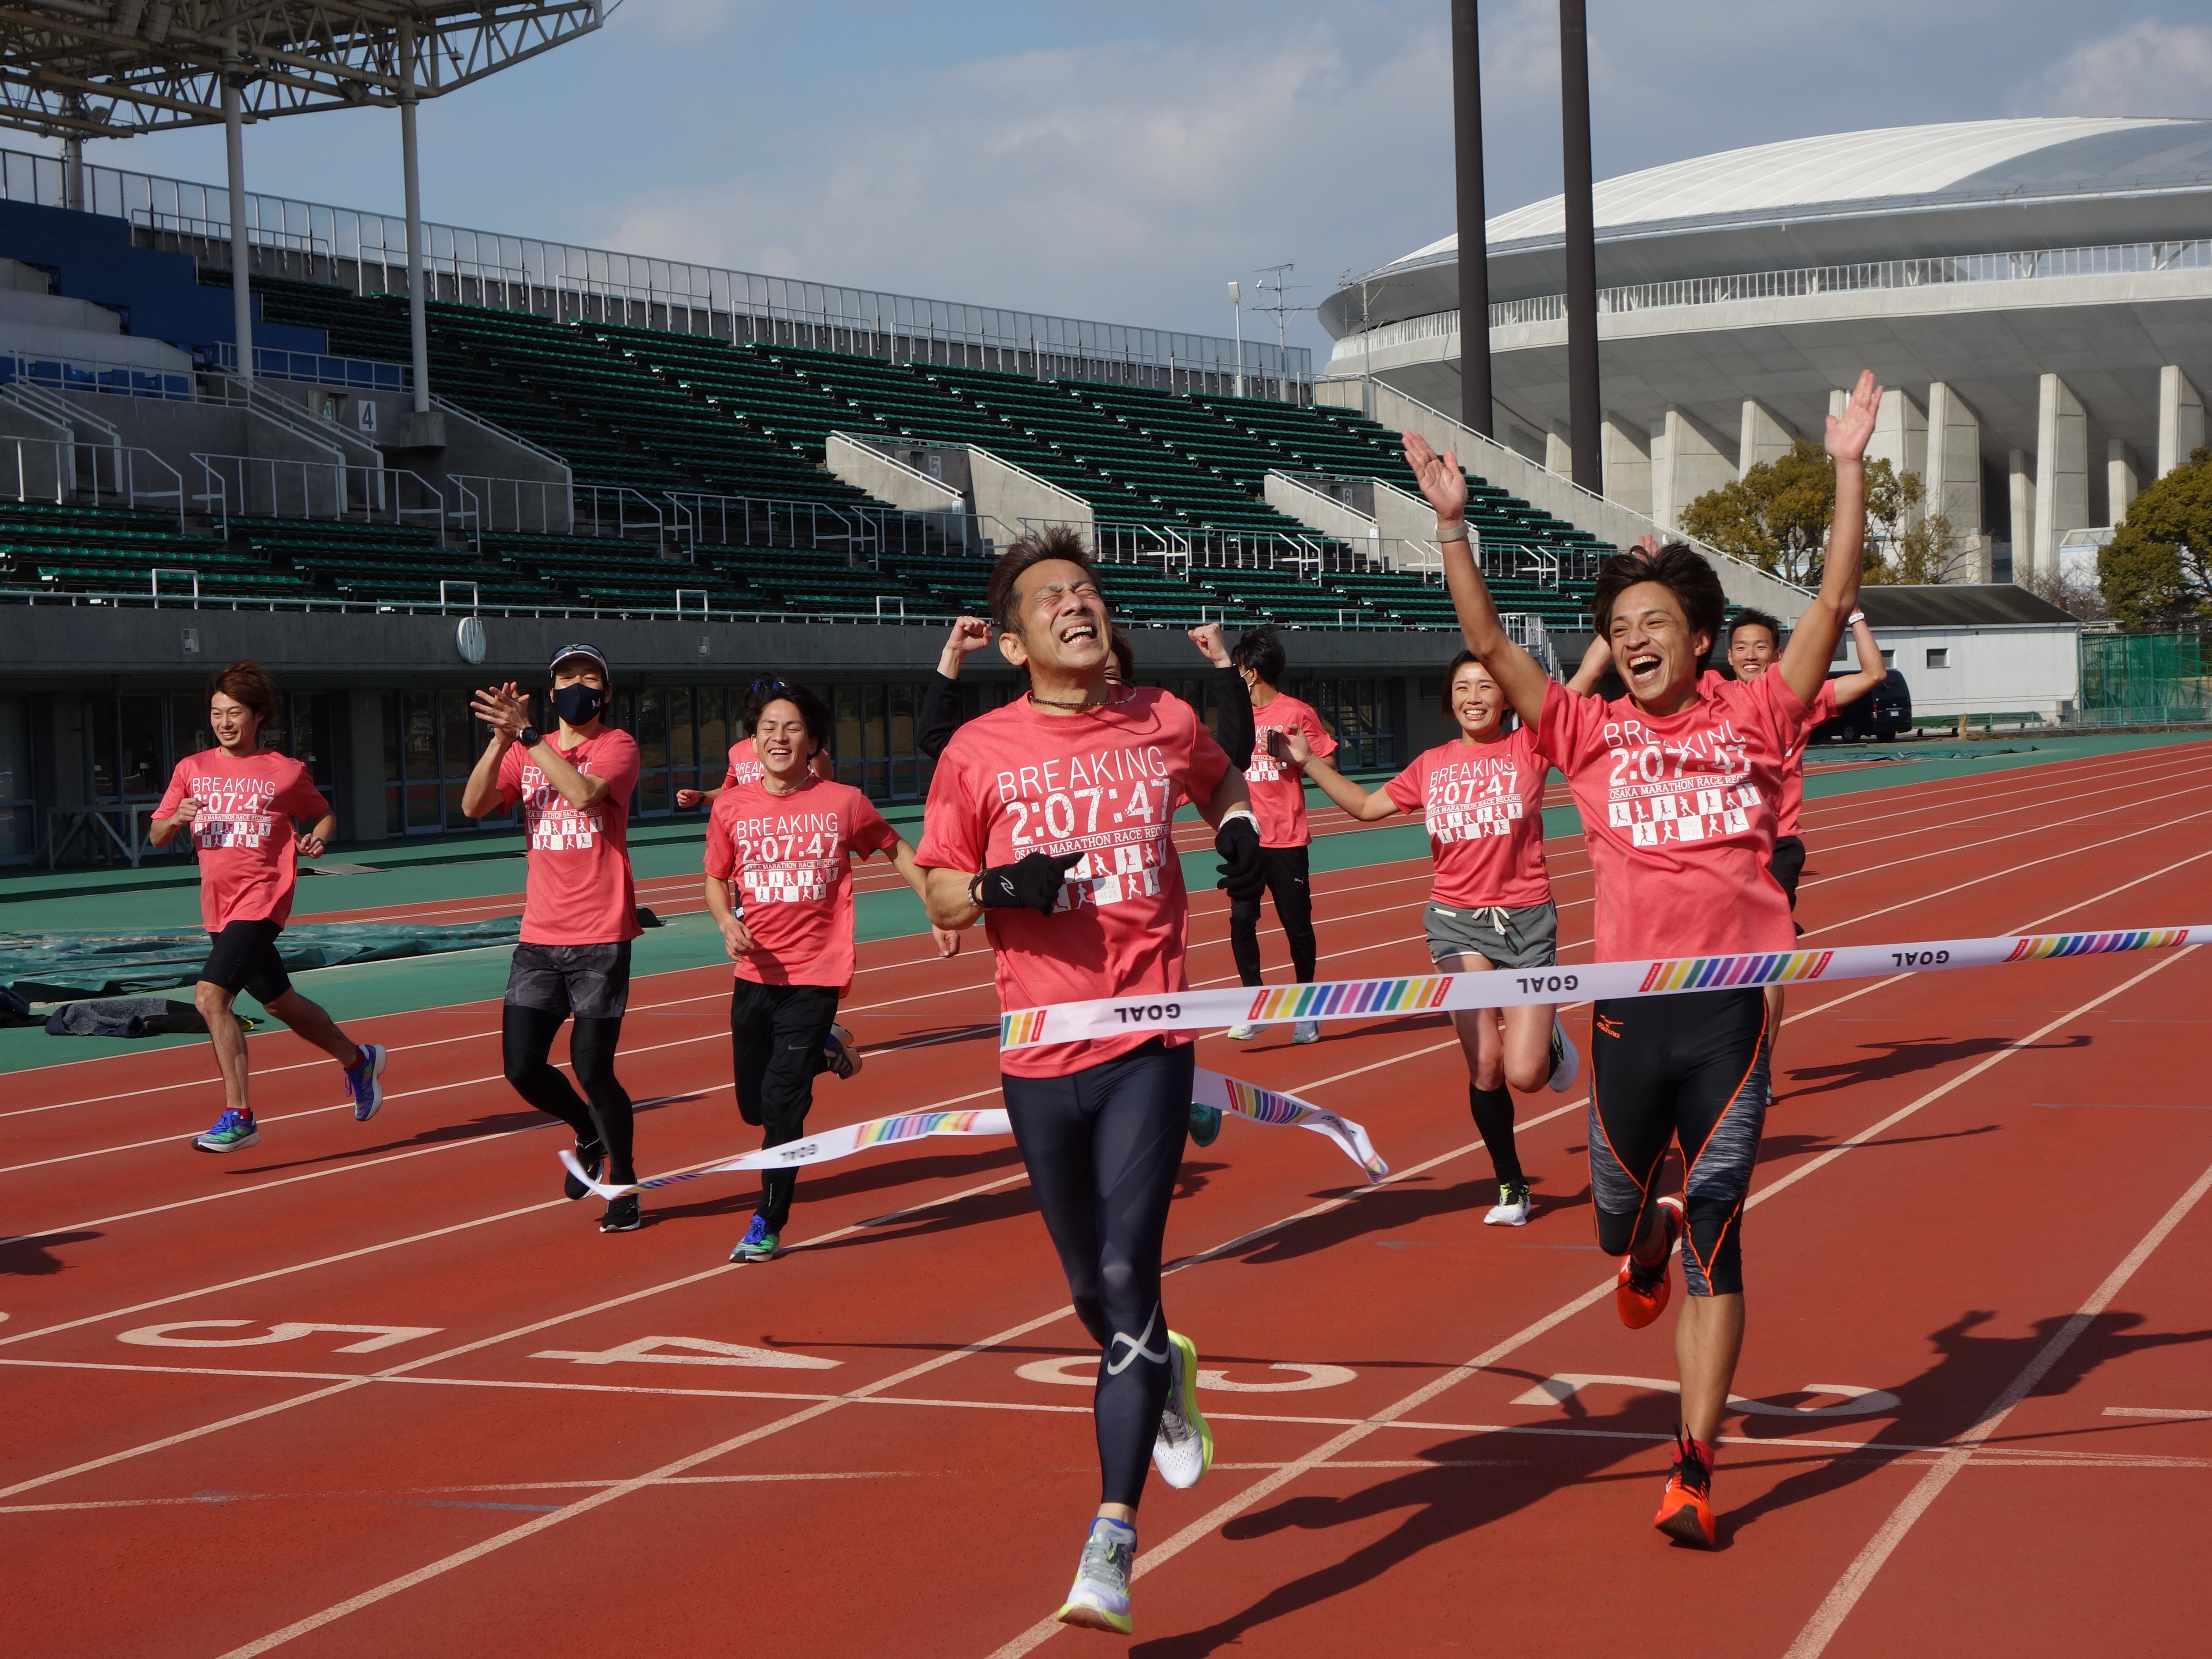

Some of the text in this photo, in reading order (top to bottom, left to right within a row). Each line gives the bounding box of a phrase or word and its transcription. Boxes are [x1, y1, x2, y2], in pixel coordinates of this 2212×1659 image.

[362, 402, 373, 429] 4
[930, 457, 940, 478] 5
[1345, 489, 1351, 506] 6
[997, 746, 1168, 804] BREAKING
[1430, 754, 1515, 788] BREAKING
[192, 777, 275, 796] BREAKING
[1427, 771, 1518, 810] 2:07:47
[1610, 789, 1637, 800] OSAKA
[1641, 779, 1692, 795] MARATHON
[1697, 777, 1723, 786] RACE
[1006, 778, 1171, 847] 2:07:47
[1442, 803, 1477, 812] MARATHON
[1496, 795, 1521, 803] RECORD
[737, 813, 838, 839] BREAKING
[738, 833, 839, 864] 2:07:47
[1050, 835, 1111, 855] MARATHON
[1115, 829, 1142, 842] RACE
[763, 862, 796, 870] MARATHON
[1098, 881, 1116, 890] 2022
[1099, 890, 1117, 900] 01.28
[1813, 953, 1829, 976] EVERNEW
[1892, 950, 1949, 966] GOAL
[1517, 975, 1578, 994] GOAL
[1644, 965, 1659, 990] EVERNEW
[1252, 991, 1266, 1018] EVERNEW
[1434, 979, 1449, 1005] EVERNEW
[1114, 1003, 1181, 1023] GOAL
[1034, 1013, 1044, 1040] EVERNEW
[117, 1319, 446, 1353] 5
[528, 1336, 845, 1369] 4
[1509, 1373, 1902, 1417] 2
